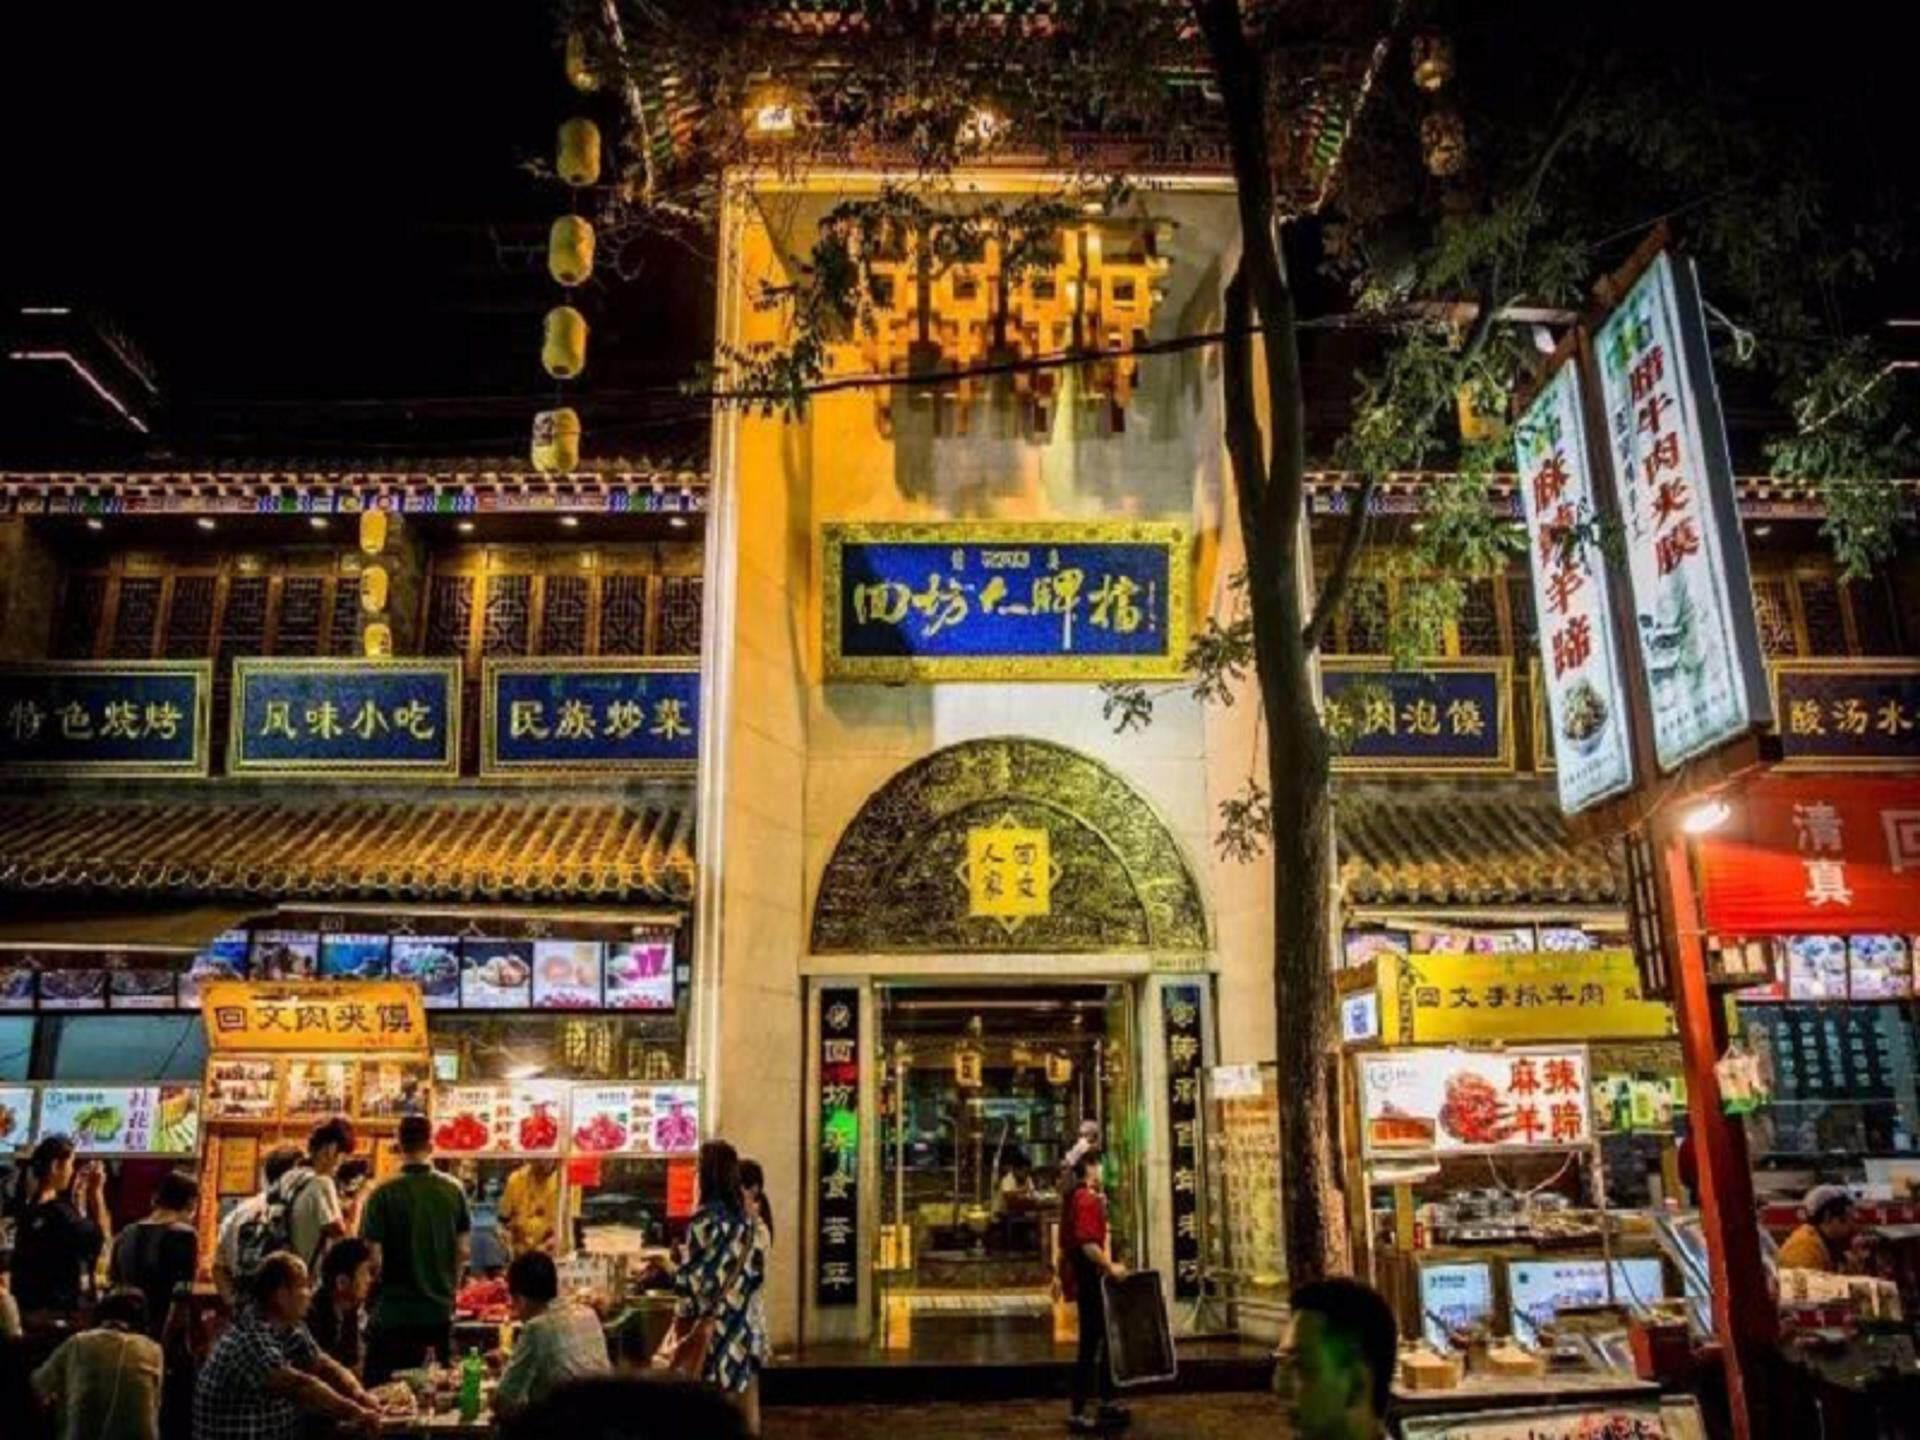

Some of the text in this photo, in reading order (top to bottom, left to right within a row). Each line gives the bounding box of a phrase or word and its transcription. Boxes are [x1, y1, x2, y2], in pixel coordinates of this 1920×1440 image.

[8, 699, 183, 741] 特色烧烤
[261, 700, 436, 740] 风味小吃
[509, 700, 692, 740] 民族炒菜
[1790, 697, 1920, 736] 酸汤水
[1793, 800, 1854, 907] 清真
[1415, 983, 1604, 1009] 回文手抓羊肉
[214, 1002, 414, 1034] 回文肉夹馍
[1508, 1058, 1581, 1096] 麻辣
[1513, 1100, 1582, 1143] 羊蹄
